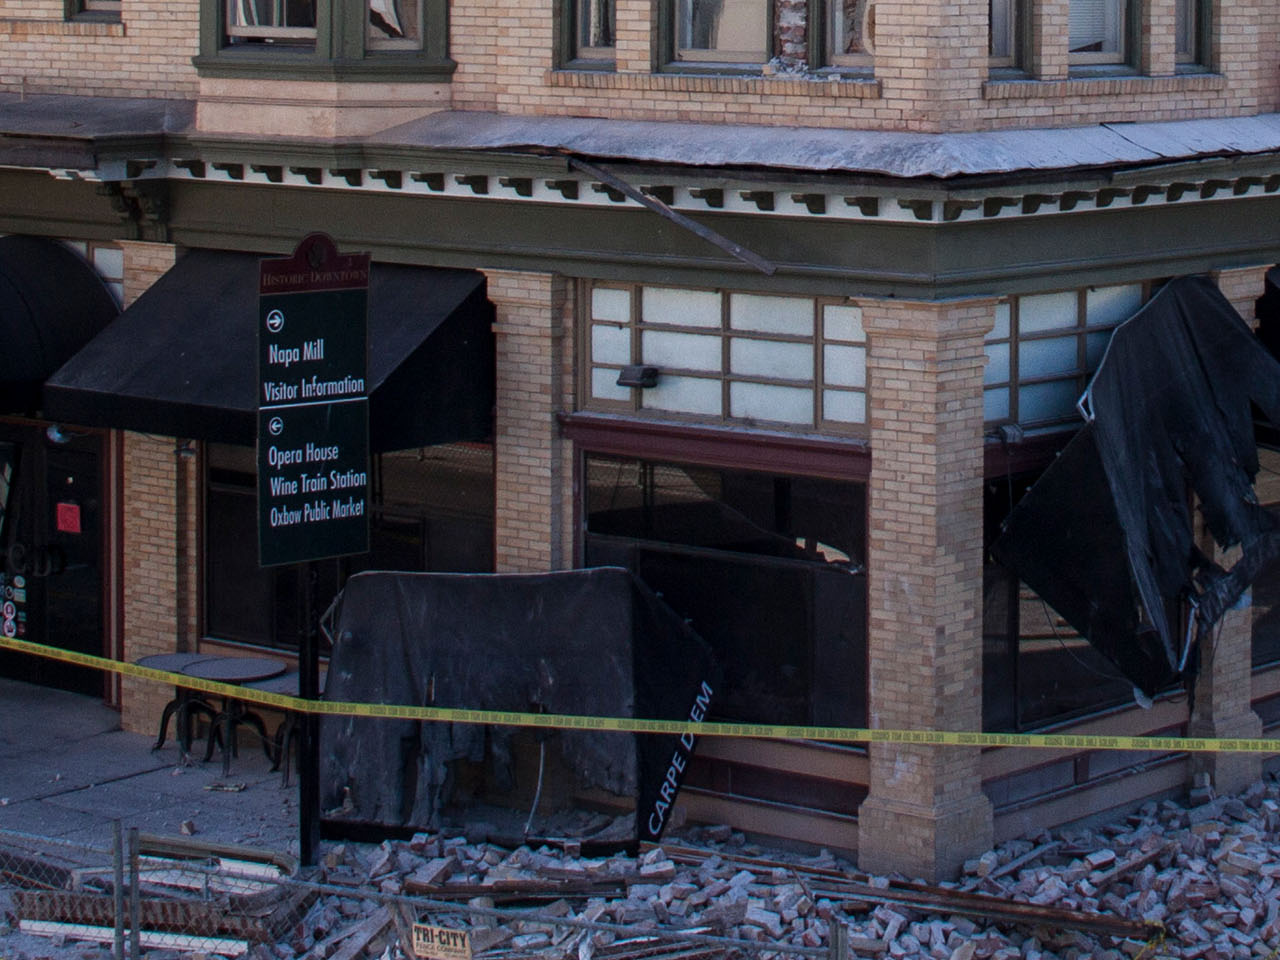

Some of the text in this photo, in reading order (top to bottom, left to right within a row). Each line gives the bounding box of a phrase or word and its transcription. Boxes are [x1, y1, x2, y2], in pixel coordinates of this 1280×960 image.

[269, 339, 324, 367] Napa Mill
[263, 375, 365, 401] Visitor Information
[269, 442, 339, 471] Opera House
[270, 469, 367, 496] Wine Train Station
[270, 496, 364, 527] Oxbow Public Market
[648, 680, 714, 835] CARPE DEM
[414, 925, 466, 948] TRI-CITY
